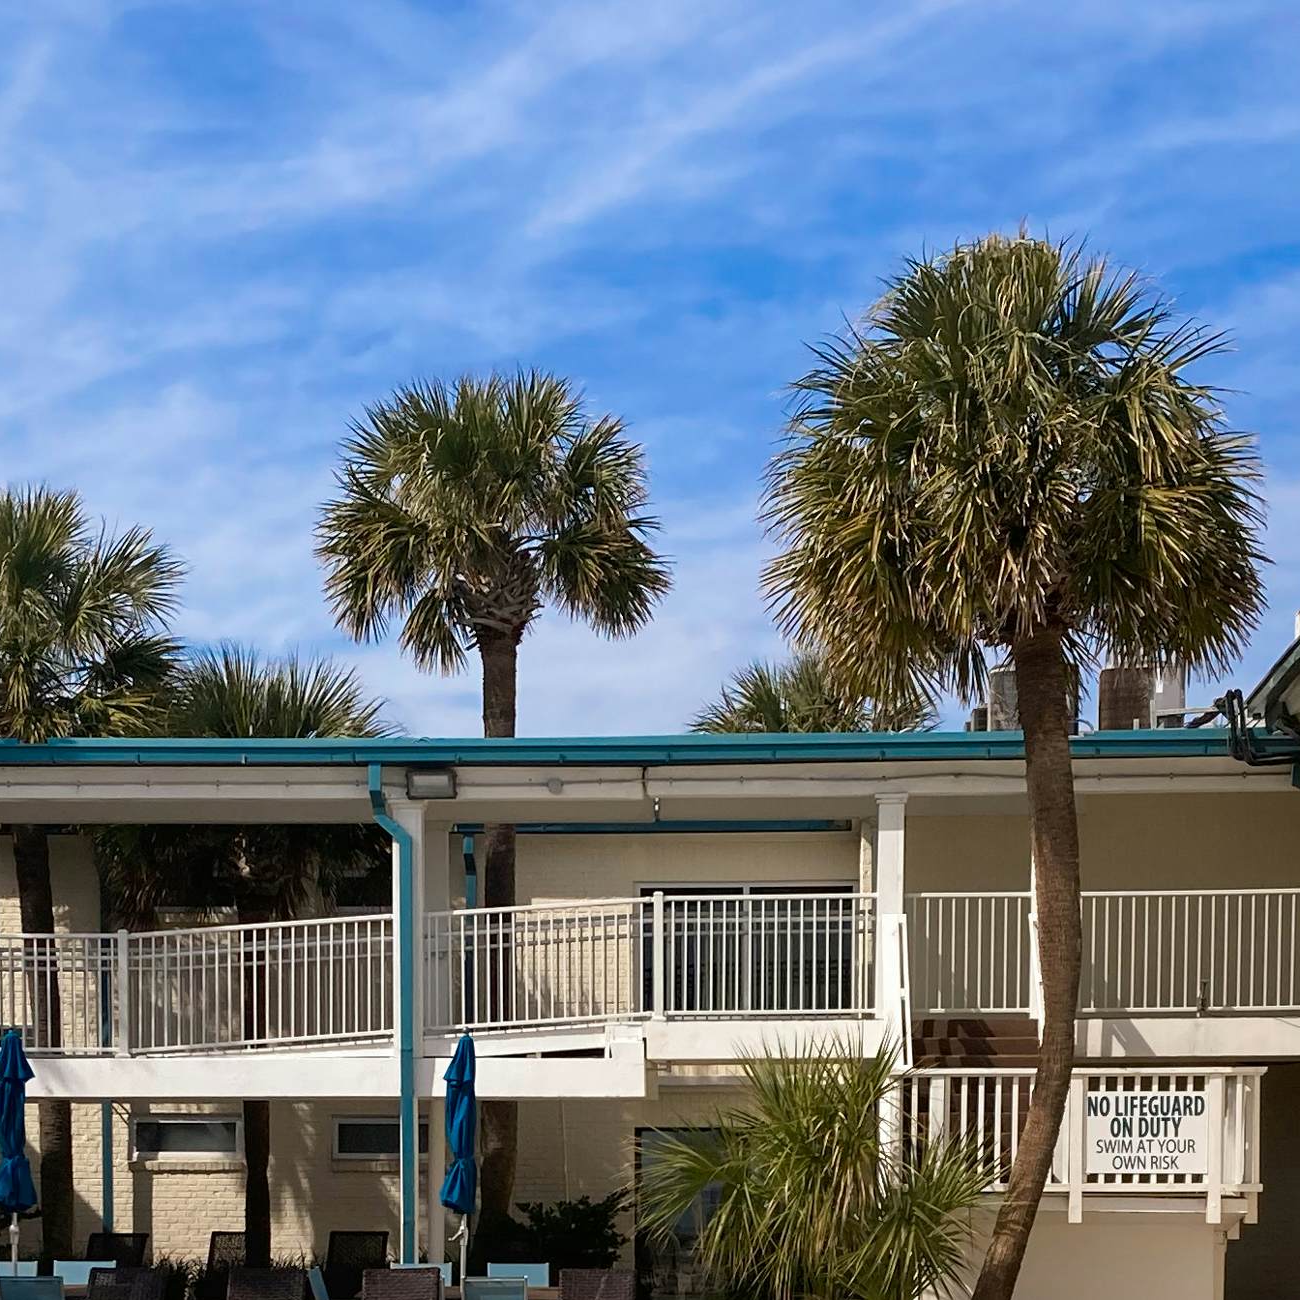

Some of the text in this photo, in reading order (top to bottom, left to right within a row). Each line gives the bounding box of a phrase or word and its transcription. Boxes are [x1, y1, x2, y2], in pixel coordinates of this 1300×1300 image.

[1087, 1095, 1205, 1117] NO LIFEGUARD
[1110, 1117, 1182, 1138] ON DUTY
[1096, 1139, 1196, 1154] SWIM AT YOUR
[1112, 1155, 1179, 1170] OWN RISK
